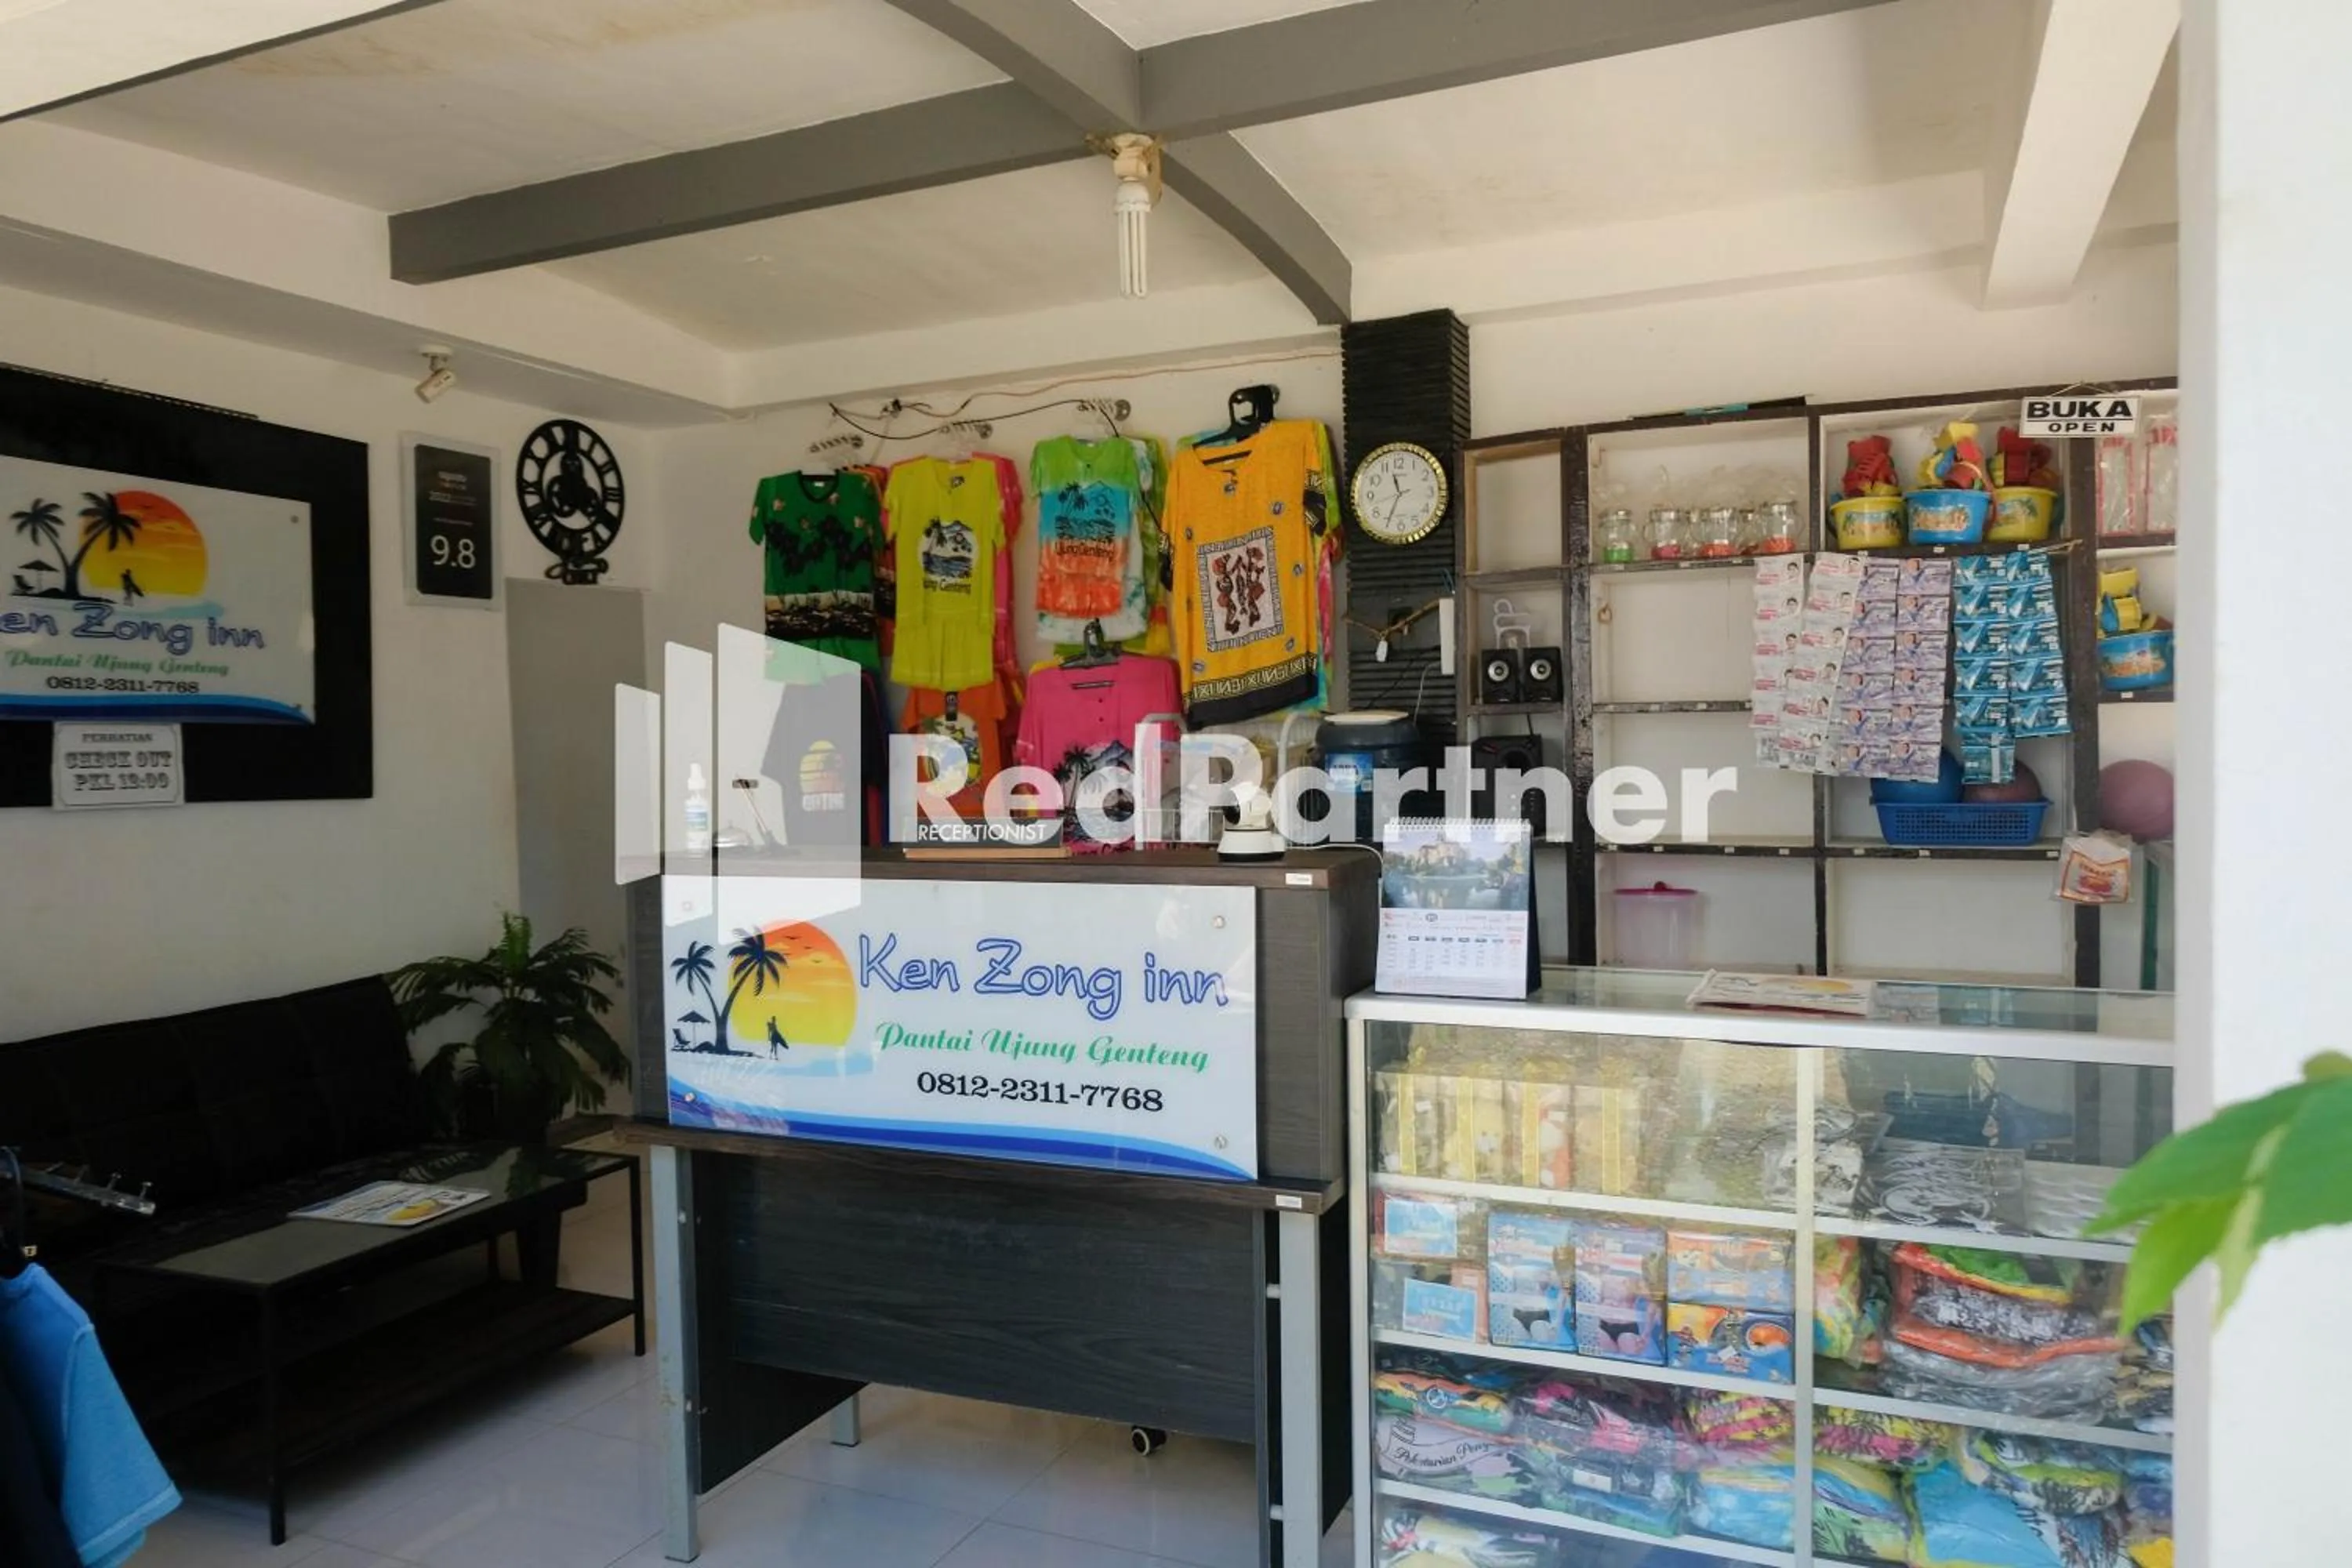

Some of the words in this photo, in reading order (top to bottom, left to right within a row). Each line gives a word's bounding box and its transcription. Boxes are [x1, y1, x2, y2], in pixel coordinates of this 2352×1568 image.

[2027, 401, 2132, 419] BUKA
[2049, 422, 2115, 433] OPEN
[430, 535, 476, 568] 9.8
[0, 612, 58, 636] en
[71, 601, 193, 655] Zong
[208, 616, 265, 648] inn
[46, 676, 200, 694] 0812-2311-7768
[65, 750, 132, 769] CHECK
[136, 750, 172, 768] OUT
[918, 823, 1047, 841] RECEPTIONIST
[858, 932, 960, 993] Ken
[974, 938, 1123, 1020] Zong
[1143, 953, 1229, 1007] inn
[876, 1022, 973, 1051] Pantai
[982, 1028, 1076, 1065] Ujung
[1087, 1035, 1208, 1073] Genteng
[916, 1071, 1163, 1112] 0812-2311-7768
